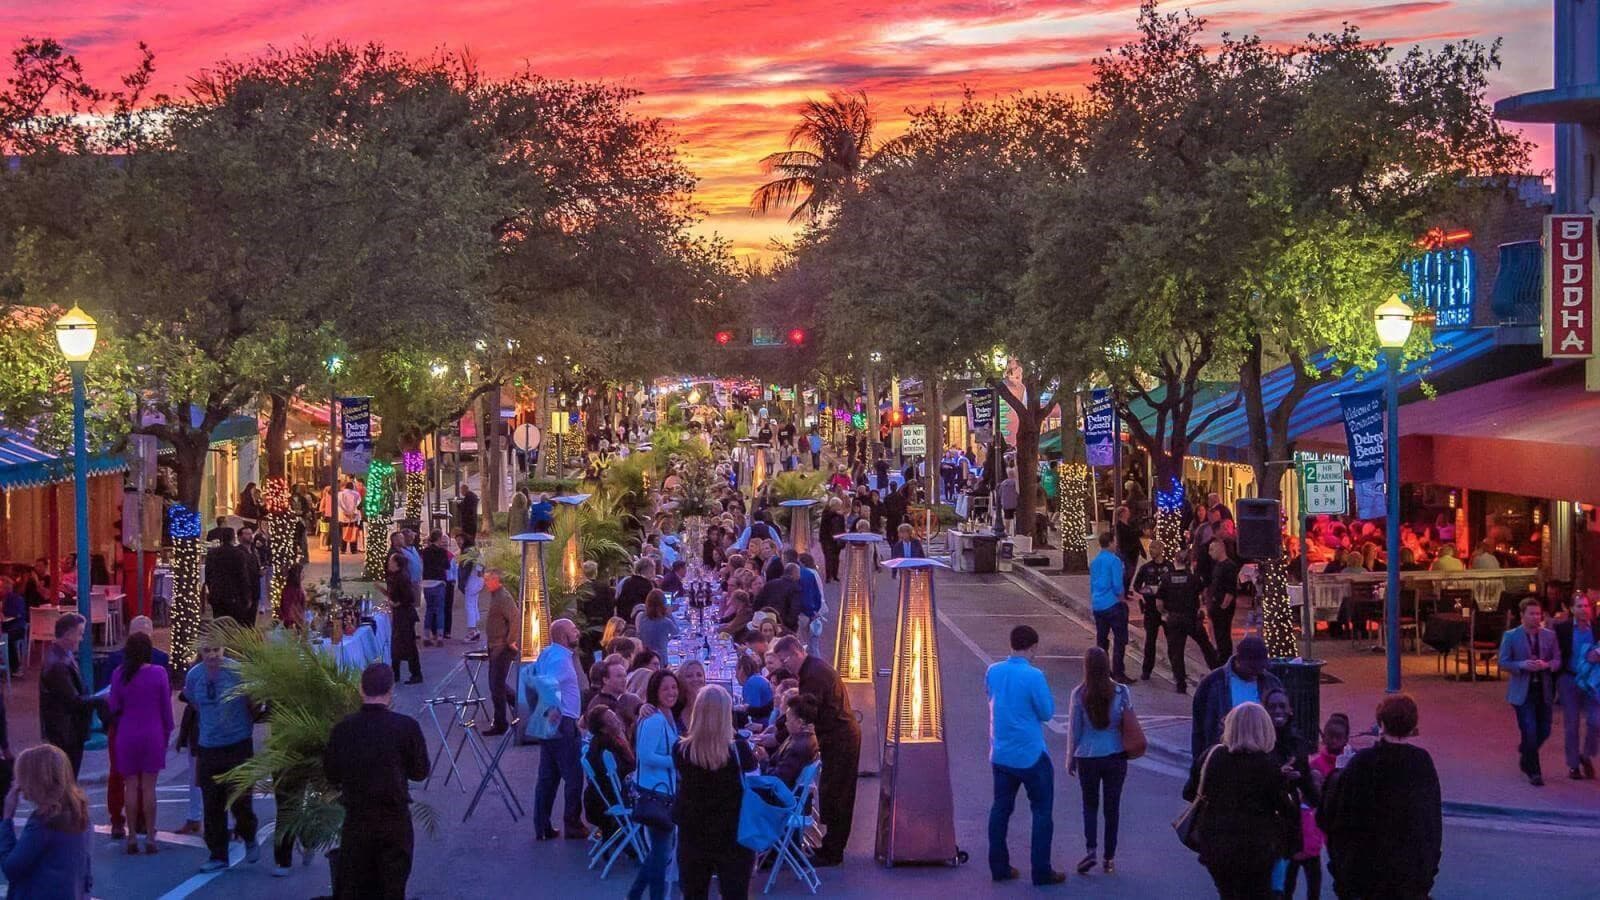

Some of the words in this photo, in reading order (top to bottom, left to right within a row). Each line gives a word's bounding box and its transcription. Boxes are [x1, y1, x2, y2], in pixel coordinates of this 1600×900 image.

[1560, 221, 1585, 352] BUDDHA
[1352, 432, 1384, 446] Delray
[1355, 443, 1384, 459] Beach
[1307, 467, 1316, 480] 2
